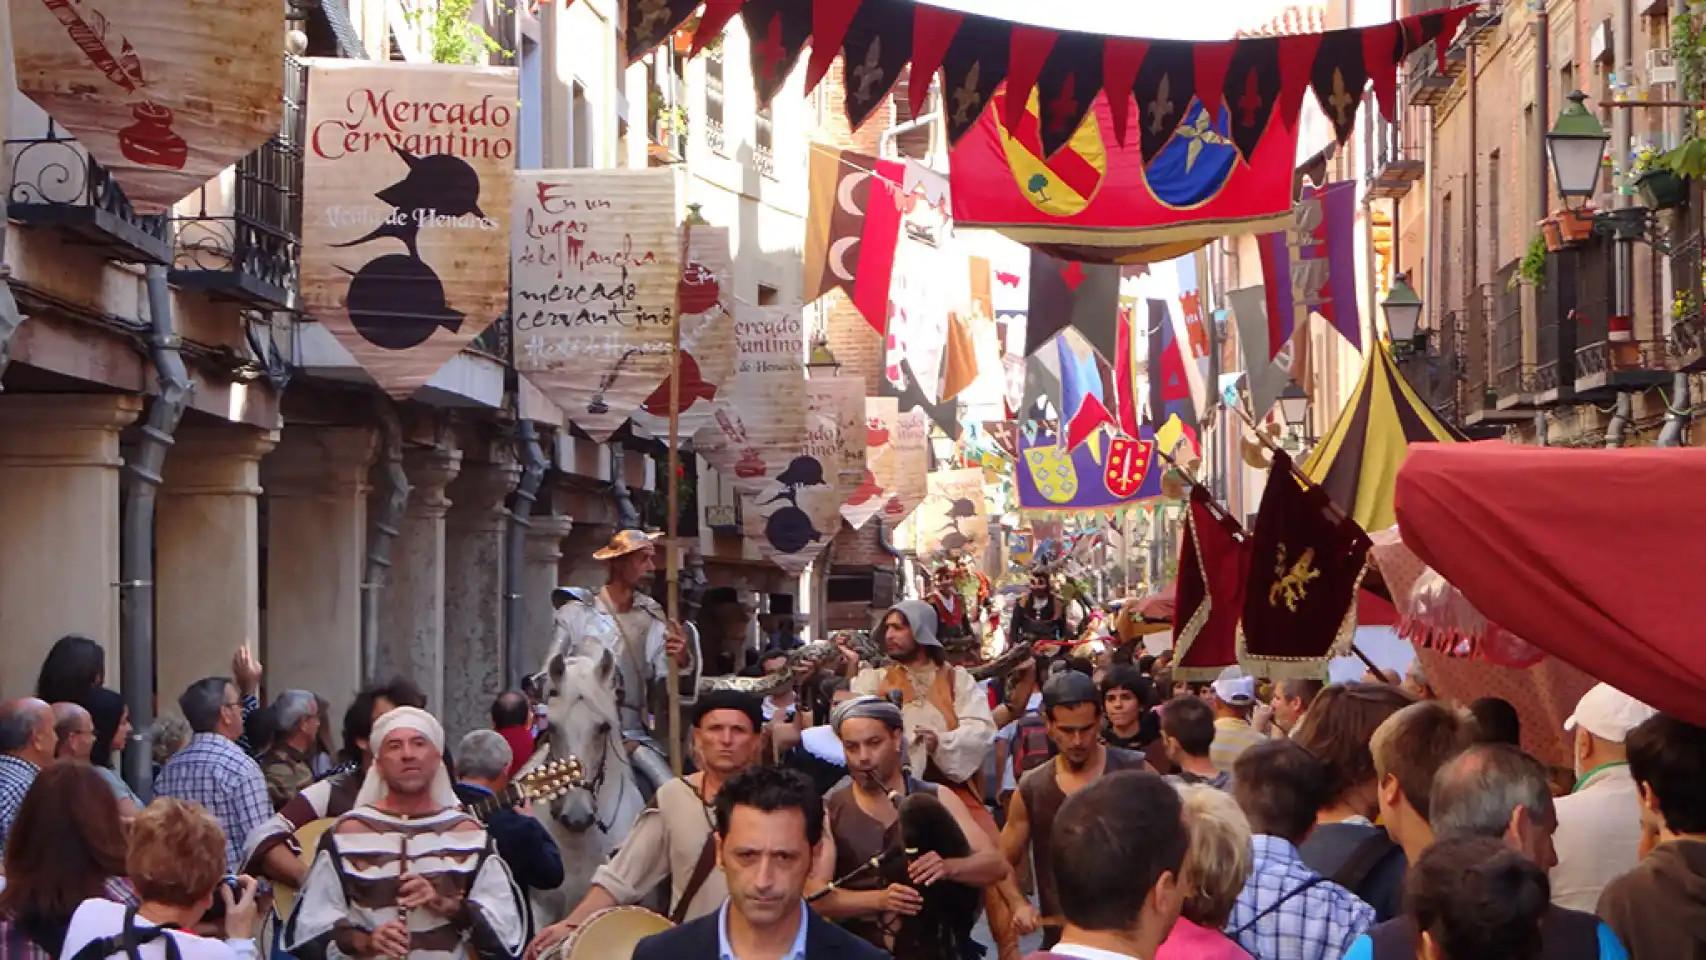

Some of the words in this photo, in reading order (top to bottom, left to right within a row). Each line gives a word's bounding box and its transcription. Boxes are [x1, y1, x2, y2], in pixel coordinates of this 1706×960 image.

[346, 88, 511, 132] Mercado
[312, 119, 512, 160] Cervantino
[536, 181, 576, 214] En
[585, 199, 611, 211] un
[386, 206, 408, 227] de
[412, 208, 498, 231] Henares
[567, 233, 657, 272] Mancha
[518, 265, 637, 307] mercado
[516, 302, 673, 331] cervantino
[735, 313, 800, 337] ercado
